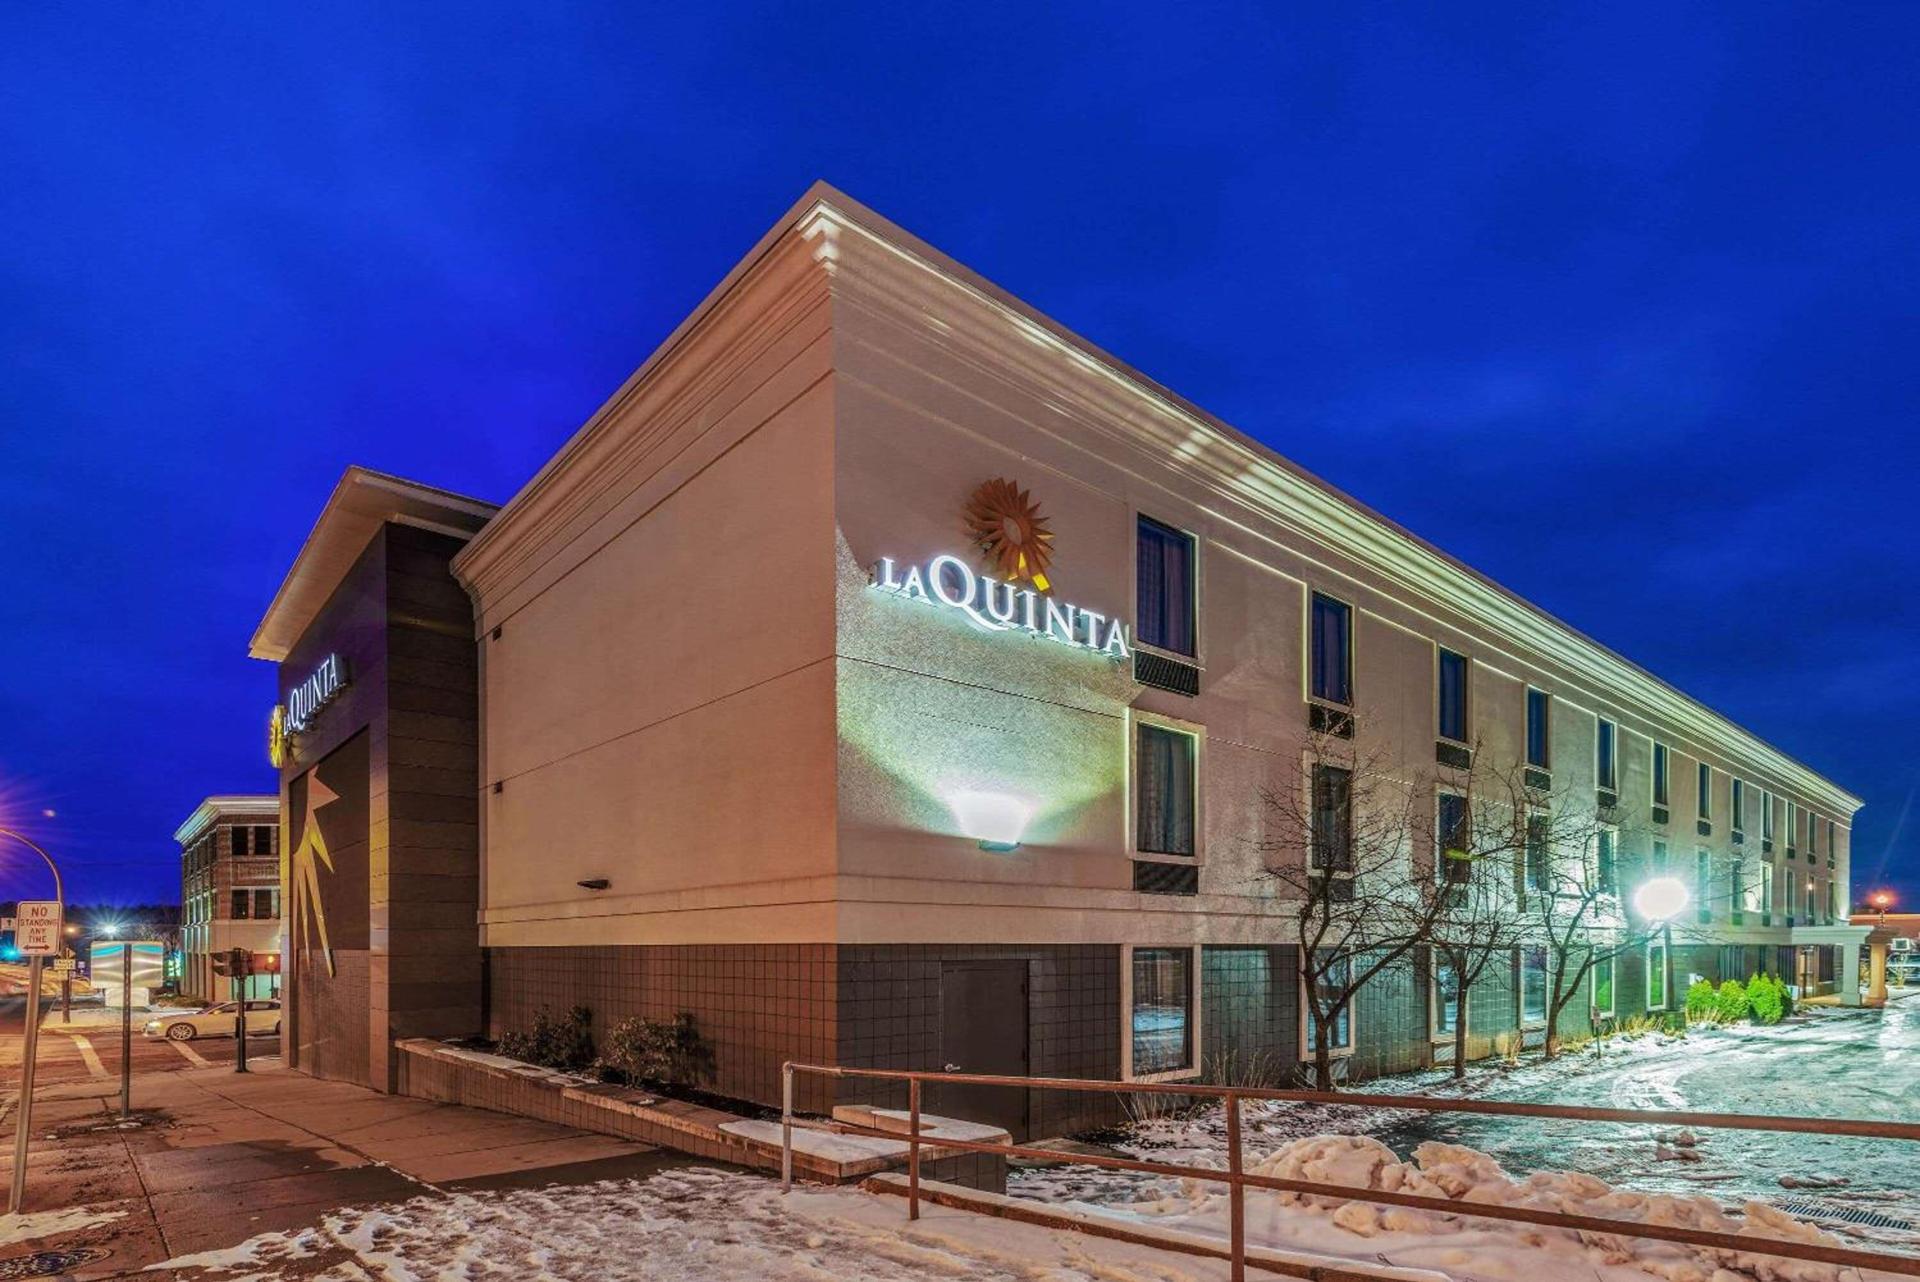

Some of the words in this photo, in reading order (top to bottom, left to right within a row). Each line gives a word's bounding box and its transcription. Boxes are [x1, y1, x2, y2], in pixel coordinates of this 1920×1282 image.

[929, 555, 1131, 658] QUINTA
[290, 652, 338, 731] QUINTA
[20, 919, 58, 927] STANDING
[31, 907, 48, 917] NO
